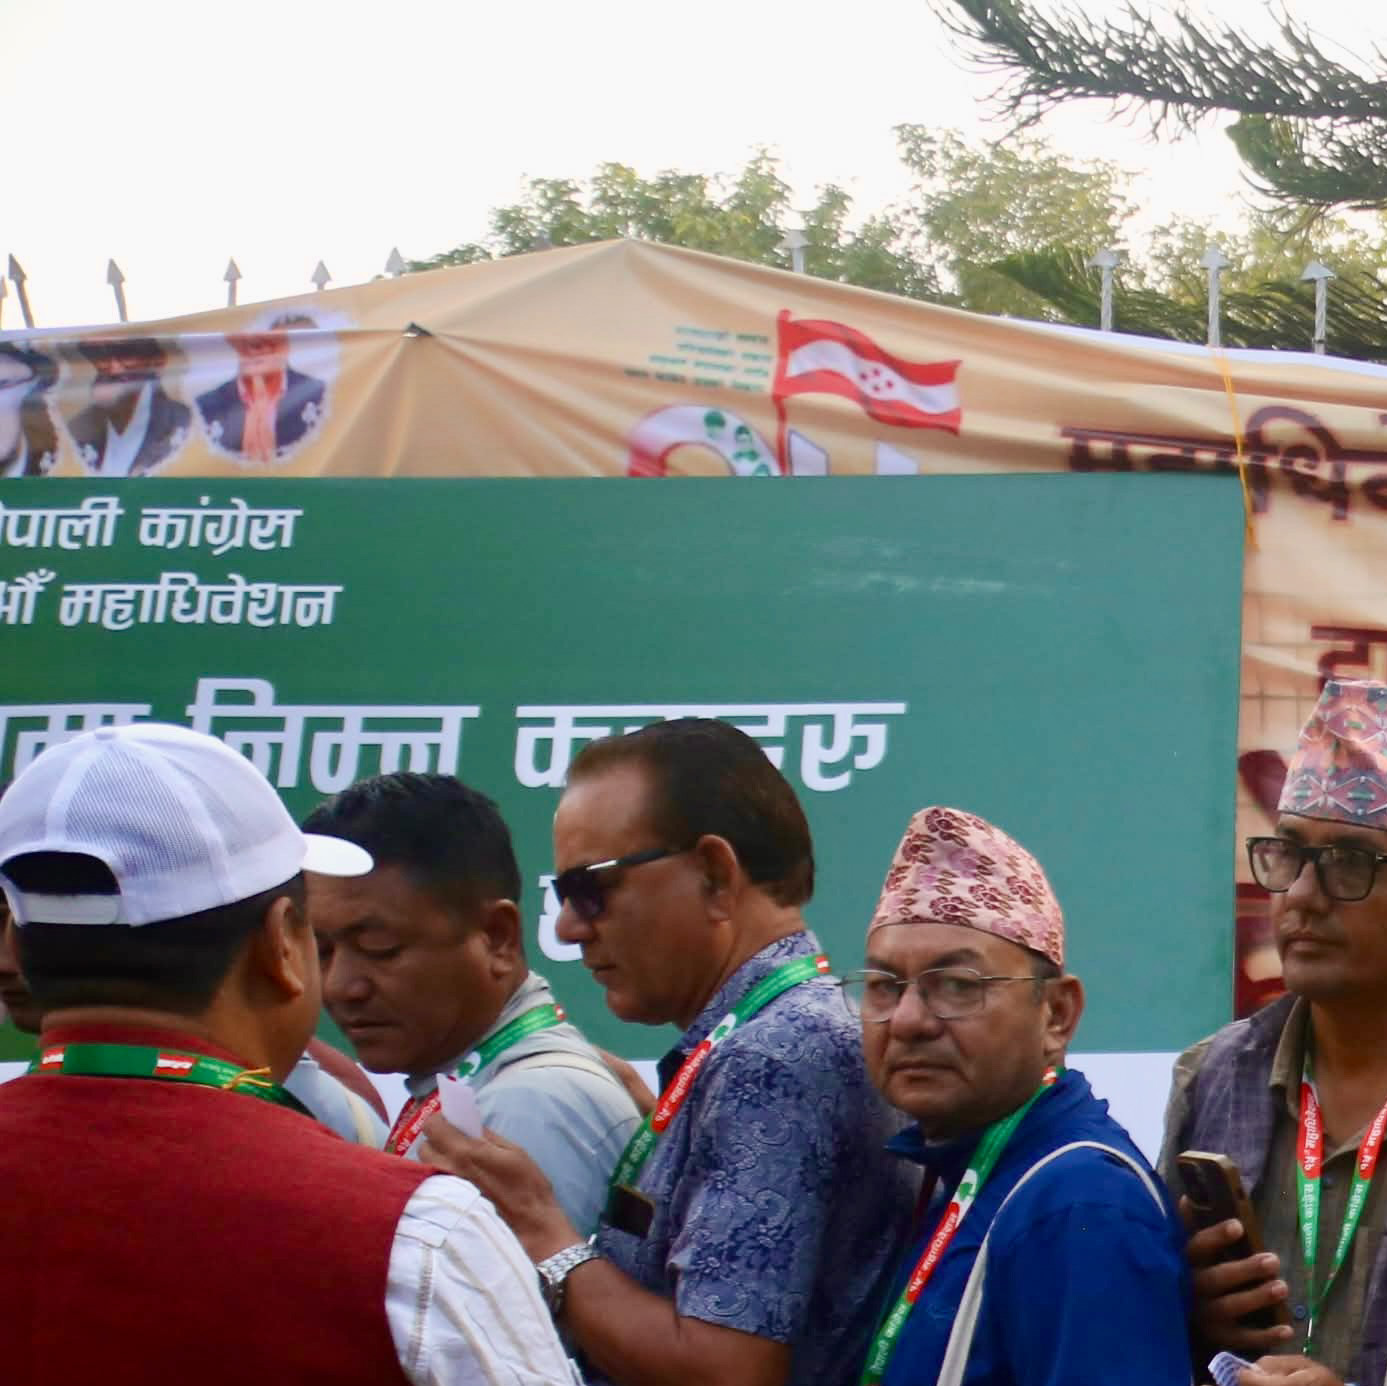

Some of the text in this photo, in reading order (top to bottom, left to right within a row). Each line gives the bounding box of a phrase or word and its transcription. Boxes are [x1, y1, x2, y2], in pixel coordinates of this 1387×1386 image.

[0, 496, 304, 555] पाली कांग्रेस
[59, 571, 345, 631] महाधिवेशन
